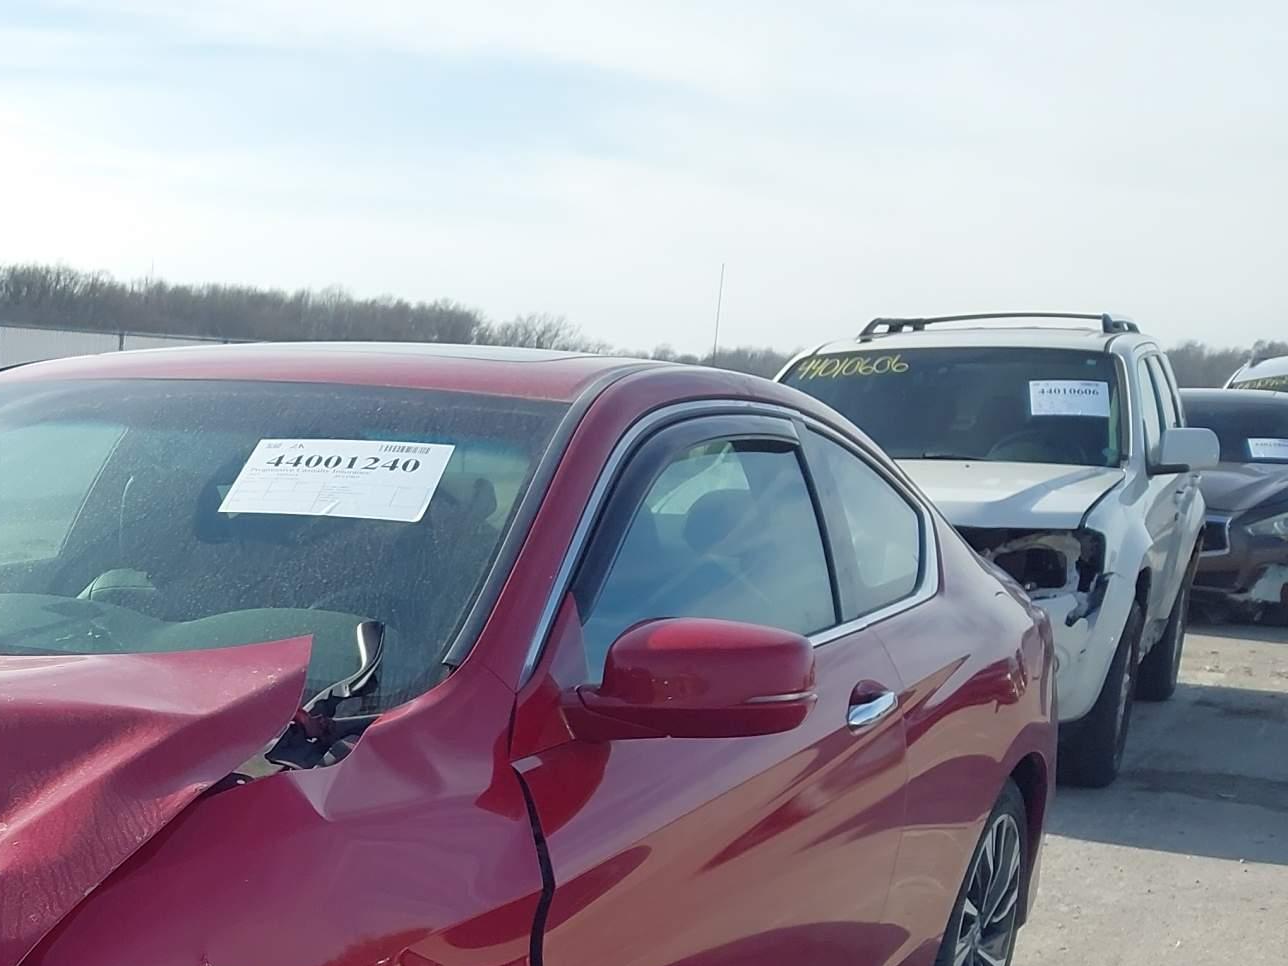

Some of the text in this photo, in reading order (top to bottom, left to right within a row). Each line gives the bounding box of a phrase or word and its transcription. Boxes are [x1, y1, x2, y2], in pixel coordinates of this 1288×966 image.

[797, 354, 910, 380] 44010606
[1038, 387, 1100, 397] 44010606
[266, 454, 421, 473] 44001240
